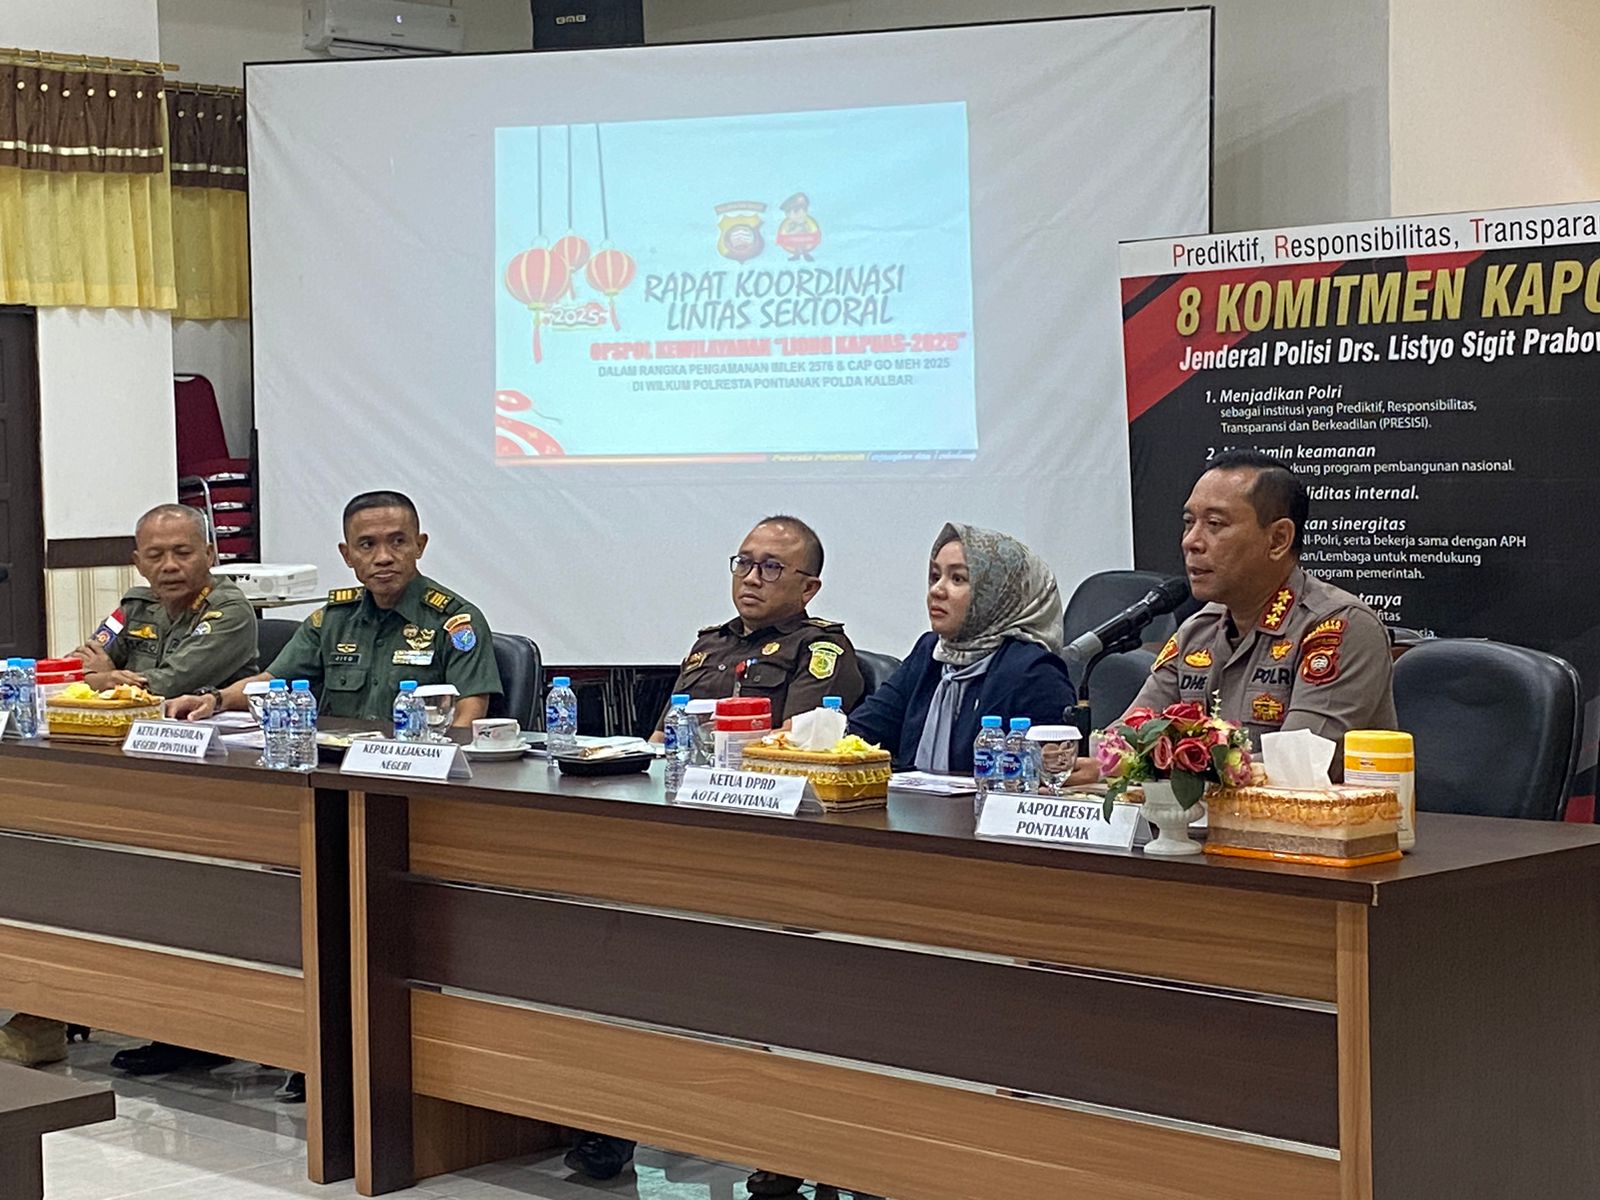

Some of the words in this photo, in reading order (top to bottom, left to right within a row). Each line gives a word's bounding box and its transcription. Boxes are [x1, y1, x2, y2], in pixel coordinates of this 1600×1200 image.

[1173, 237, 1265, 267] Prediktif,
[1275, 224, 1459, 261] Responsibilitas,
[1469, 215, 1600, 244] Transpara
[644, 270, 727, 303] RAPAT
[735, 264, 905, 298] KOORDINASI
[1176, 286, 1201, 336] 8
[1216, 267, 1466, 333] KOMITMEN
[667, 299, 751, 331] LINTAS
[760, 295, 894, 328] SEKTORAL
[1179, 341, 1267, 371] Jenderal
[1273, 338, 1332, 366] Polisi
[1338, 337, 1380, 363] Drs.
[1387, 334, 1454, 365] Listyo
[1461, 329, 1516, 363] Sigit
[1522, 326, 1600, 355] Prabo
[598, 365, 637, 377] DALAM
[639, 364, 687, 376] RANGKA
[689, 362, 769, 375] PENGAMANAN
[847, 359, 872, 371] CAP
[874, 359, 892, 370] GO
[895, 358, 921, 370] MEH
[923, 357, 950, 369] 2025
[632, 381, 644, 391] DI
[646, 379, 691, 391] WILKUM
[693, 378, 751, 390] POLRESTA
[754, 376, 820, 389] PONTIANAK
[822, 375, 862, 388] POLDA
[864, 374, 913, 386] KALBAR
[1205, 390, 1217, 403] 1.
[1219, 386, 1304, 405] Menjadikan
[1307, 384, 1343, 399] Polri
[1220, 406, 1261, 419] sebagai
[1263, 404, 1304, 416] institusi
[1306, 405, 1334, 417] yang
[1336, 400, 1385, 413] Prediktif,
[1387, 398, 1477, 414] Responsibilitas,
[1220, 420, 1286, 435] Transparansi
[1288, 420, 1310, 432] dan
[1312, 418, 1377, 431] Berkeadilan
[1379, 416, 1432, 431] (PRESISI).
[1296, 444, 1377, 460] keamanan
[1323, 462, 1372, 477] program
[1373, 460, 1460, 476] pembangunan
[1461, 459, 1515, 472] nasional.
[1354, 484, 1420, 501] internal.
[1331, 516, 1407, 534] sinergitas
[1343, 536, 1371, 546] serta
[1373, 534, 1416, 549] bekerja
[1418, 536, 1449, 546] sama
[1451, 535, 1497, 549] dengan
[1499, 535, 1527, 548] APH
[1373, 551, 1408, 562] untuk
[1409, 551, 1482, 566] mendukung
[1356, 567, 1425, 580] pemerintah.
[136, 726, 159, 737] KETUA
[158, 741, 199, 754] PONTIANAK
[363, 743, 394, 755] KEPALA
[395, 745, 442, 758] KEJAKSAAN
[380, 760, 412, 771] NEGERI
[709, 773, 743, 787] KETUA
[745, 776, 776, 790] DPRD
[690, 789, 720, 802] KOTA
[720, 792, 781, 810] PONTIANAK
[1016, 801, 1101, 821] KAPOLRESTA
[1015, 820, 1091, 841] PONTIANAK
